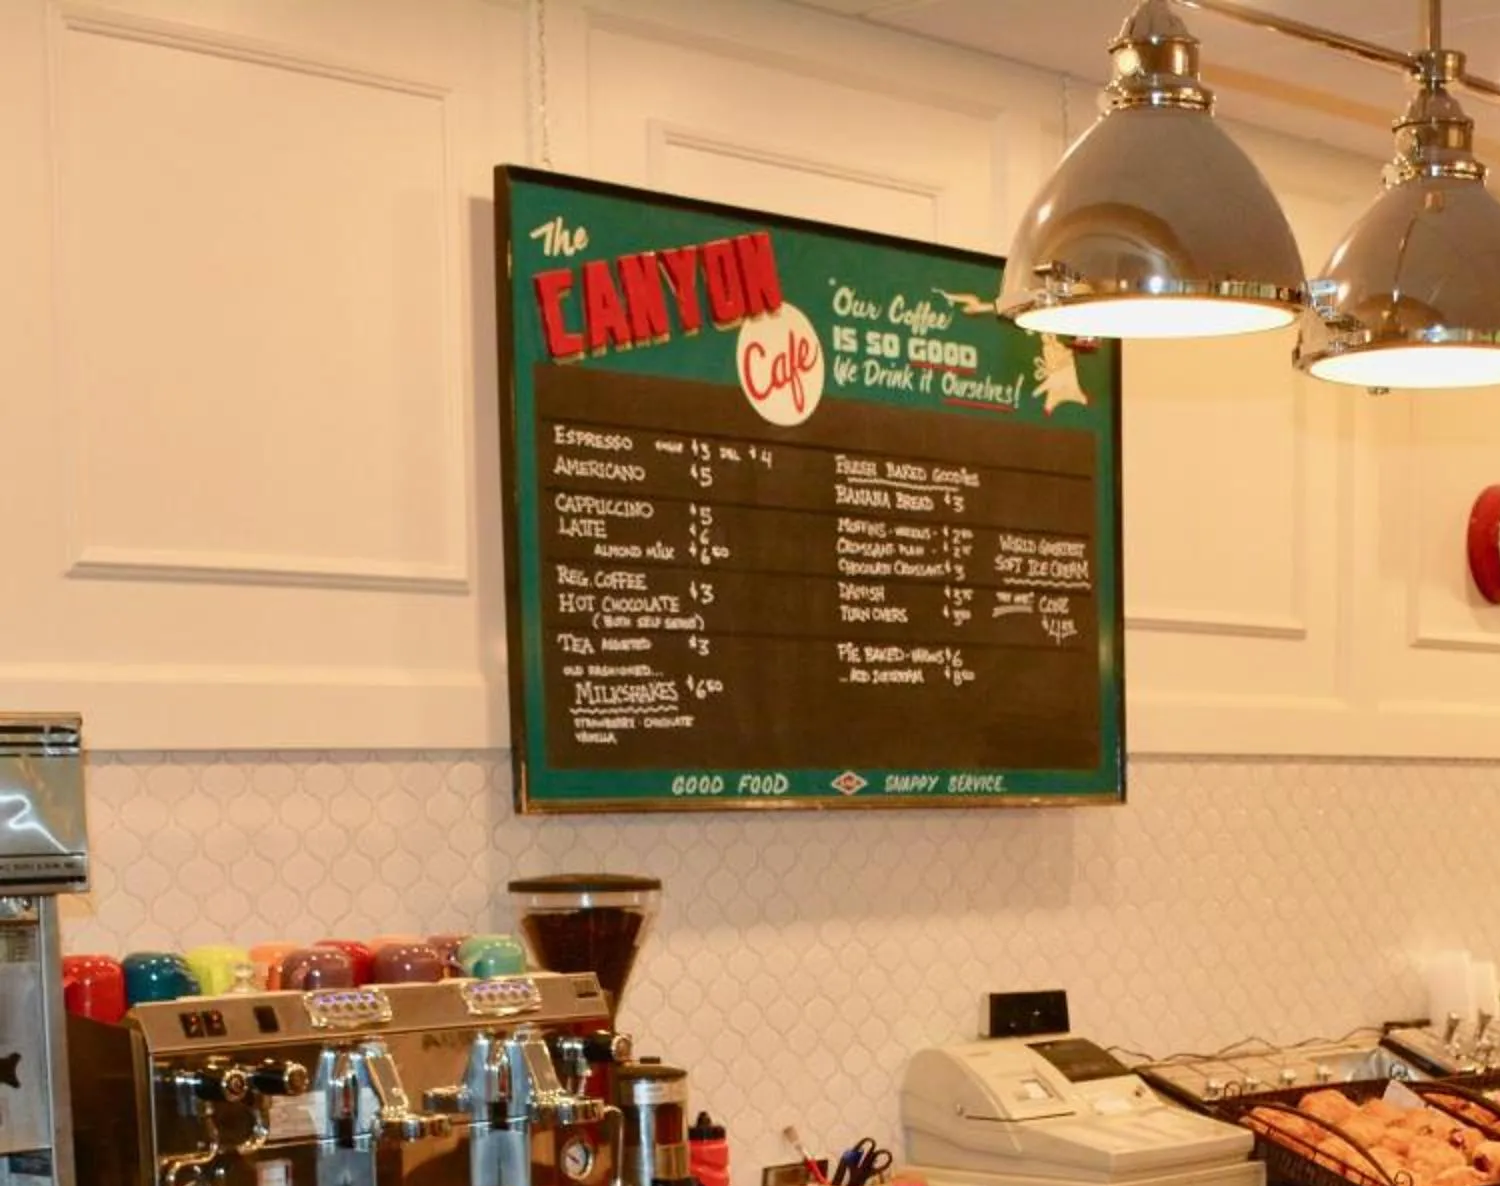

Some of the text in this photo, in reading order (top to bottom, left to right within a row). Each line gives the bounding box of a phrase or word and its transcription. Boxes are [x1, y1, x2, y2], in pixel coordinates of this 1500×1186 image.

[530, 216, 590, 256] The
[532, 230, 783, 365] CANYON
[888, 294, 954, 335] Coffee
[833, 325, 977, 368] IS SO GOOD
[744, 330, 818, 413] Cafe
[833, 354, 858, 386] We
[863, 359, 914, 391] Drink
[554, 425, 633, 451] ESPRESSO
[553, 456, 646, 482] AMERICANO
[554, 493, 654, 519] CAPPUCCINO
[835, 484, 891, 509] BANANA
[895, 492, 934, 511] BREAD
[557, 517, 607, 539] LATTE
[593, 543, 642, 558] ALMOND
[594, 571, 649, 591] COFFEE
[558, 593, 681, 613] HOT CHOCOLATE
[557, 633, 595, 655] TEA
[575, 681, 679, 705] MILKSHAKES
[672, 773, 790, 795] GOOD FOOD
